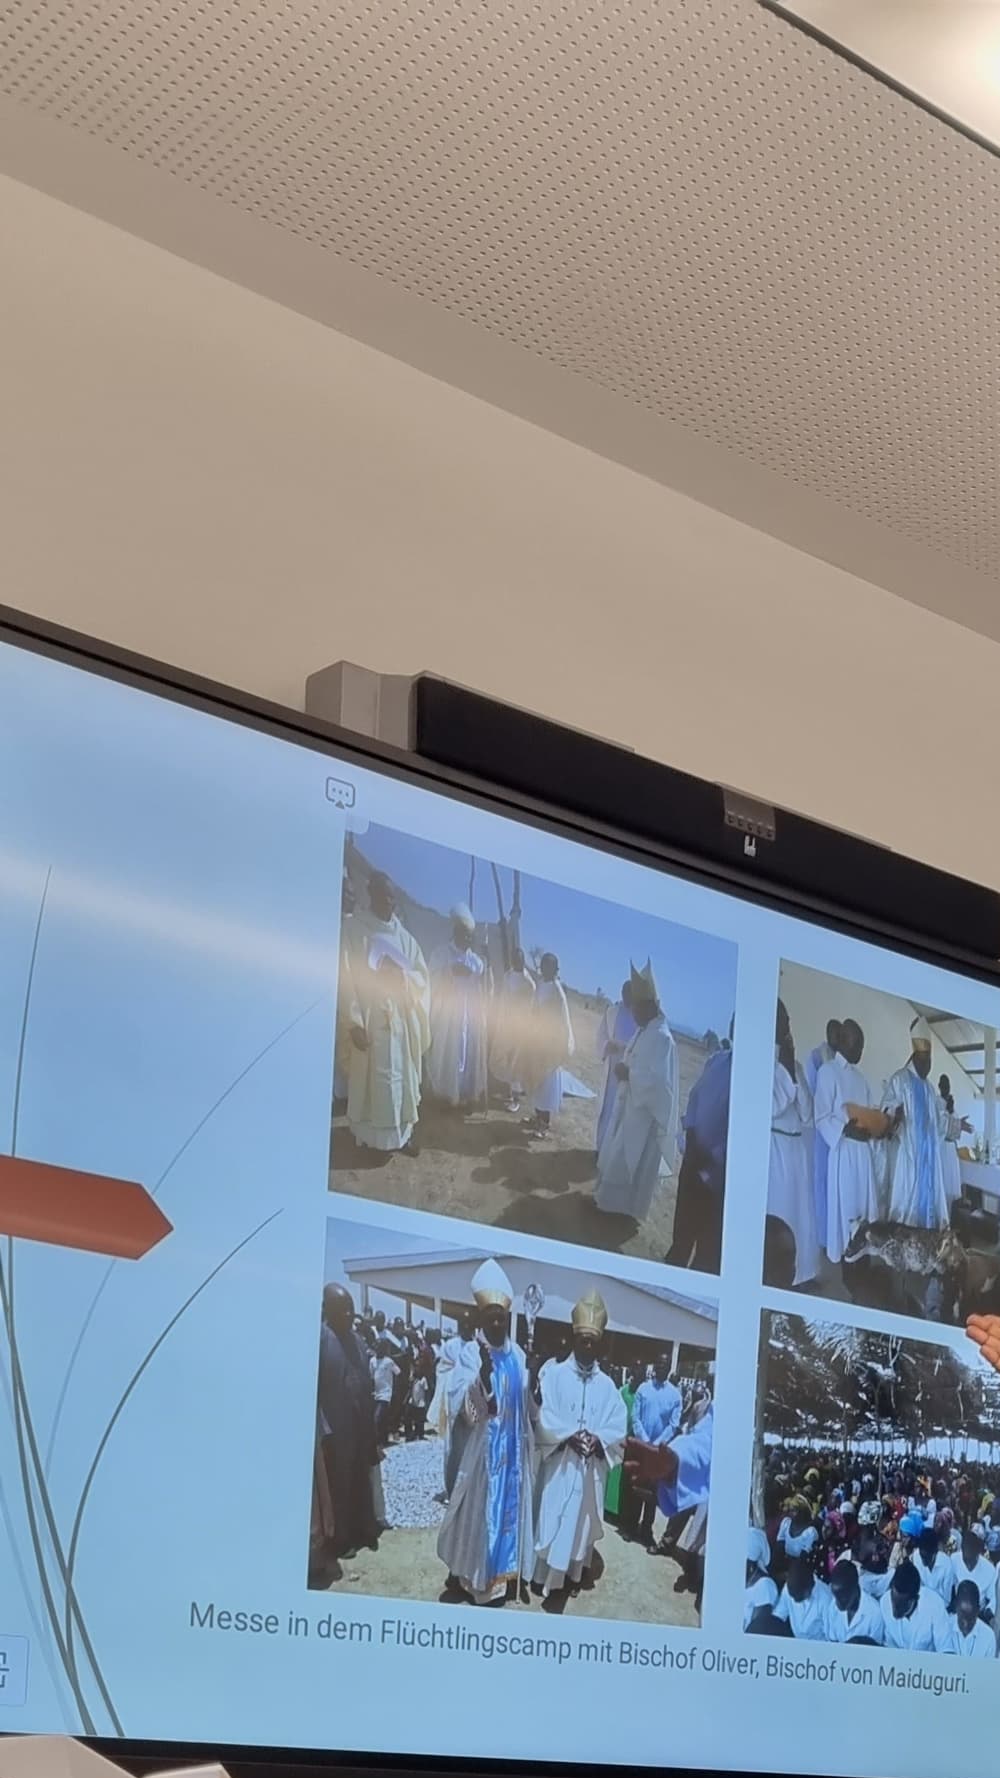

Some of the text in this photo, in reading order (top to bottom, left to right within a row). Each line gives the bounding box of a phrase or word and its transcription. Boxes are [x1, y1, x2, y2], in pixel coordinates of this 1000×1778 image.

[189, 1601, 970, 1697] Messe in dem Flüchtlingscamp mit Bischof Oliver, Bischof von Maiduguri.
